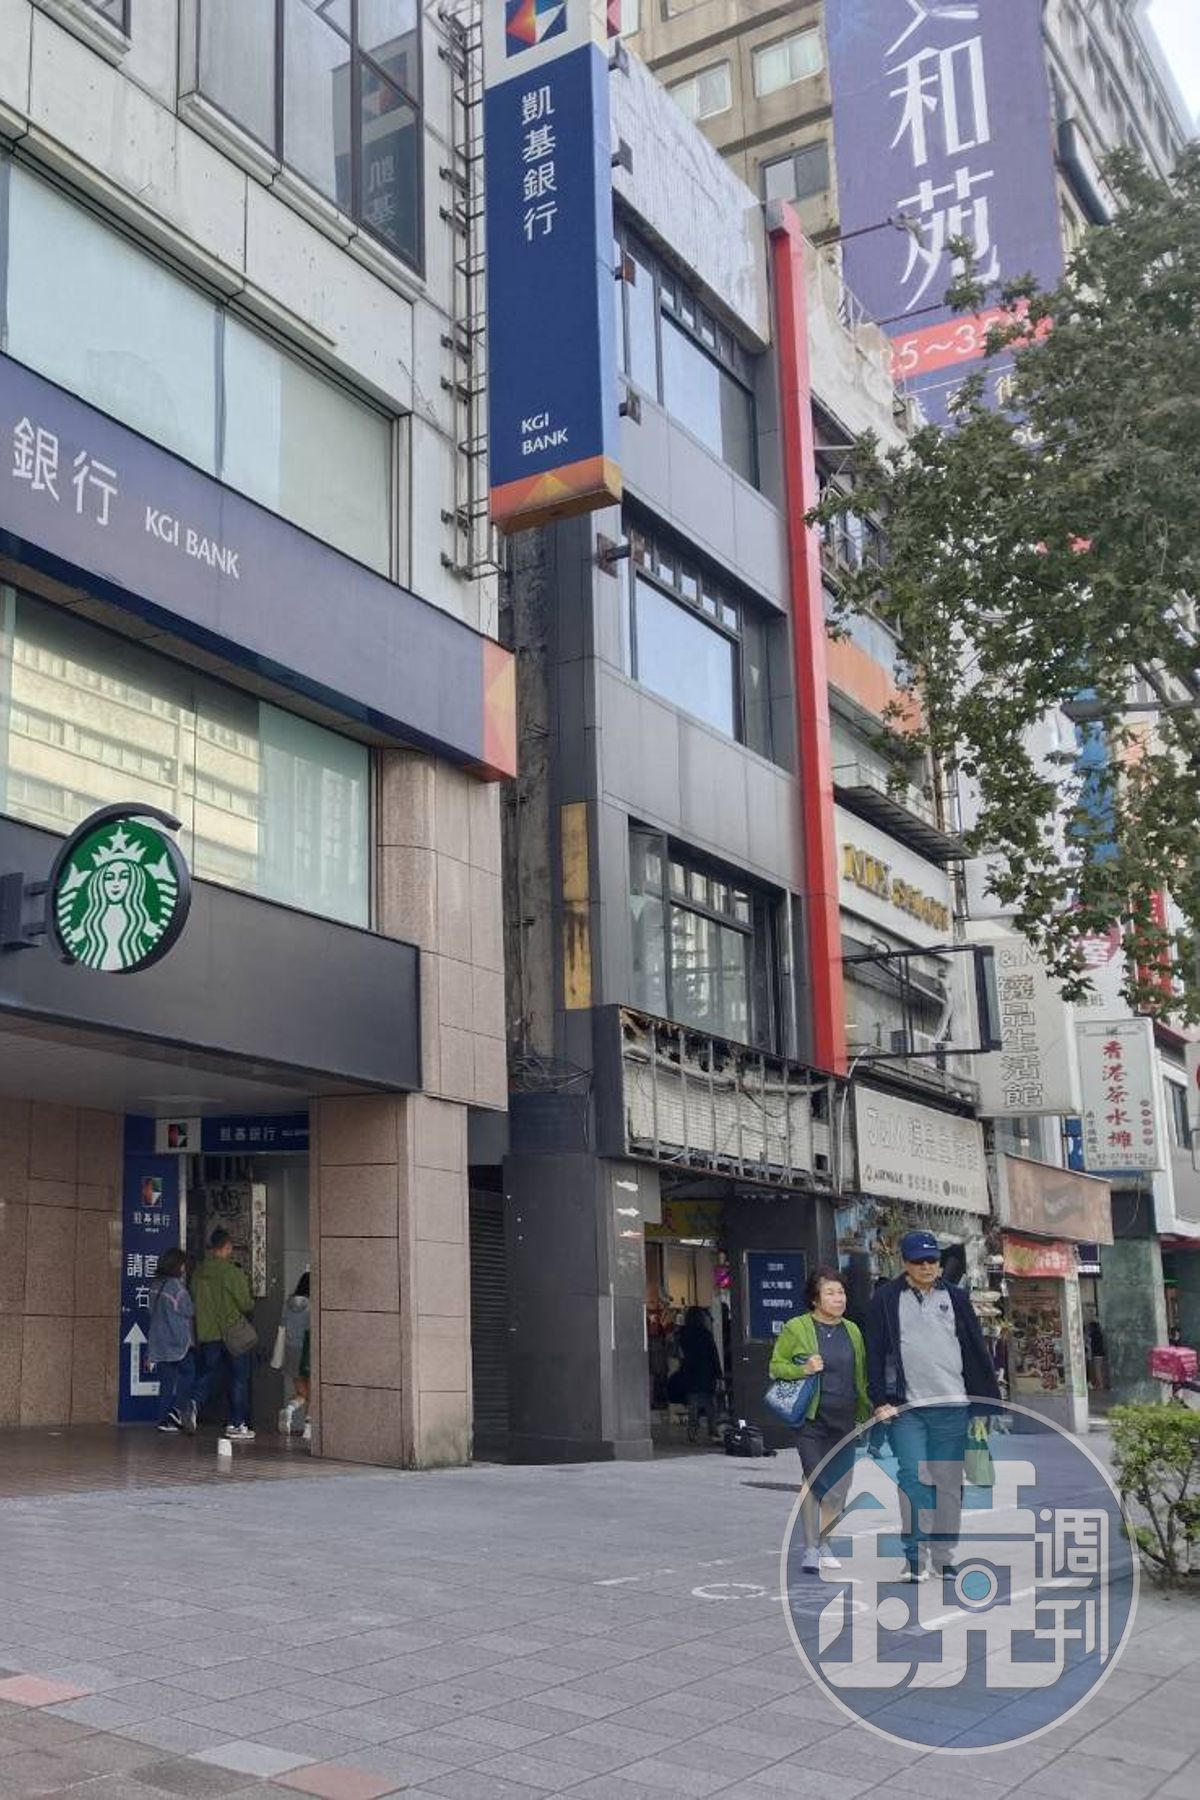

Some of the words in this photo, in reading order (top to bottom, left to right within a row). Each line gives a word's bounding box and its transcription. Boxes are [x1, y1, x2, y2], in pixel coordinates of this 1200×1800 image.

[521, 85, 558, 241] 凱基銀行
[521, 411, 549, 434] KGI
[521, 427, 569, 455] BANK
[145, 505, 179, 546] KGI
[185, 529, 240, 580] BANK
